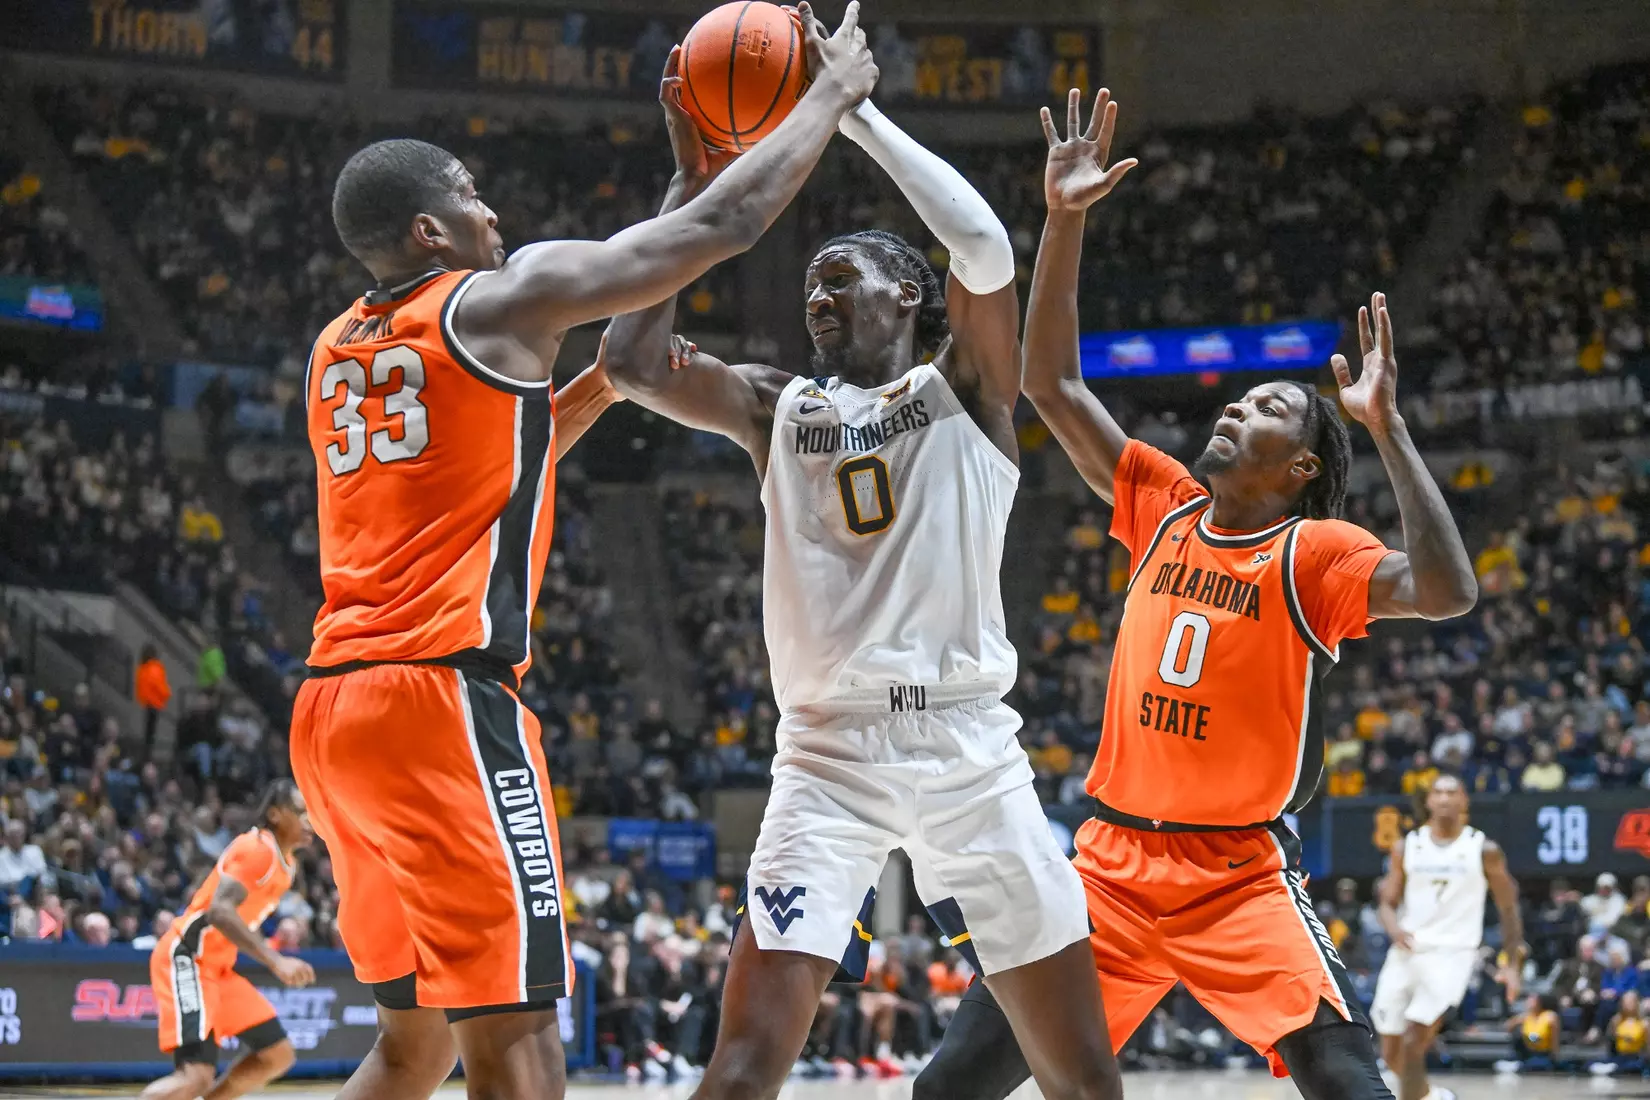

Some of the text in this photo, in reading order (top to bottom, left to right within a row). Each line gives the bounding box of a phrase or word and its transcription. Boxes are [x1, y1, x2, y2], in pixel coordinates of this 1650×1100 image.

[90, 6, 207, 57] THORN
[292, 26, 333, 70] 44
[916, 57, 1003, 99] WEST
[320, 344, 430, 477] 33
[795, 399, 930, 454] MOUNTAINEERS
[835, 454, 896, 536] 0
[1150, 562, 1260, 621] OKLAHOMA
[1157, 610, 1211, 688] 0
[889, 685, 926, 712] WVU
[1139, 691, 1211, 741] STATE
[494, 767, 558, 917] COWBOYS
[1536, 804, 1589, 865] 38
